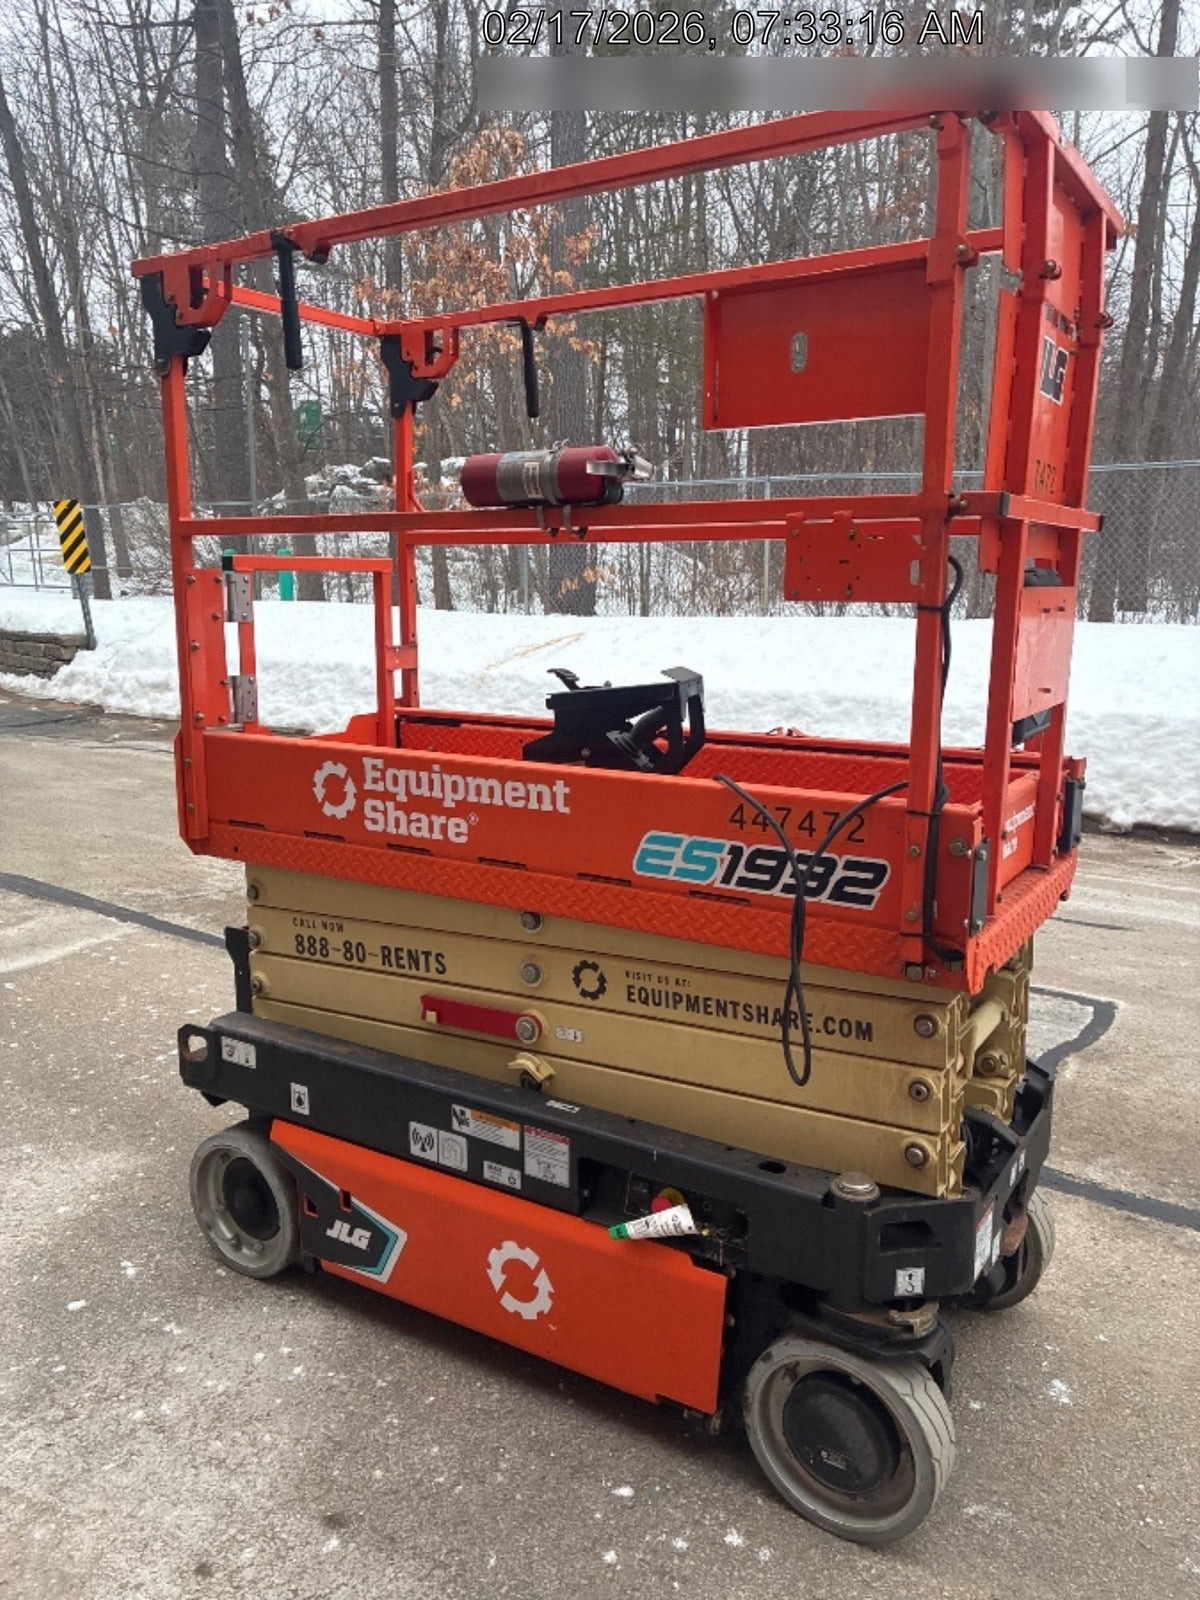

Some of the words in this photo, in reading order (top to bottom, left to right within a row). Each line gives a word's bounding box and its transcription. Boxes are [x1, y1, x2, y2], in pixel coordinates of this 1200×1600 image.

[361, 756, 571, 814] Equipment
[728, 803, 866, 843] 447472
[634, 831, 890, 909] ES1932
[292, 916, 317, 929] CALL
[321, 920, 344, 933] NOW
[294, 933, 448, 975] 888-80-RENTS
[625, 970, 652, 983] VISIT
[657, 975, 670, 986] US
[626, 984, 875, 1043] EQUIPMENTSHARE.COM
[325, 1219, 372, 1250] JLG
